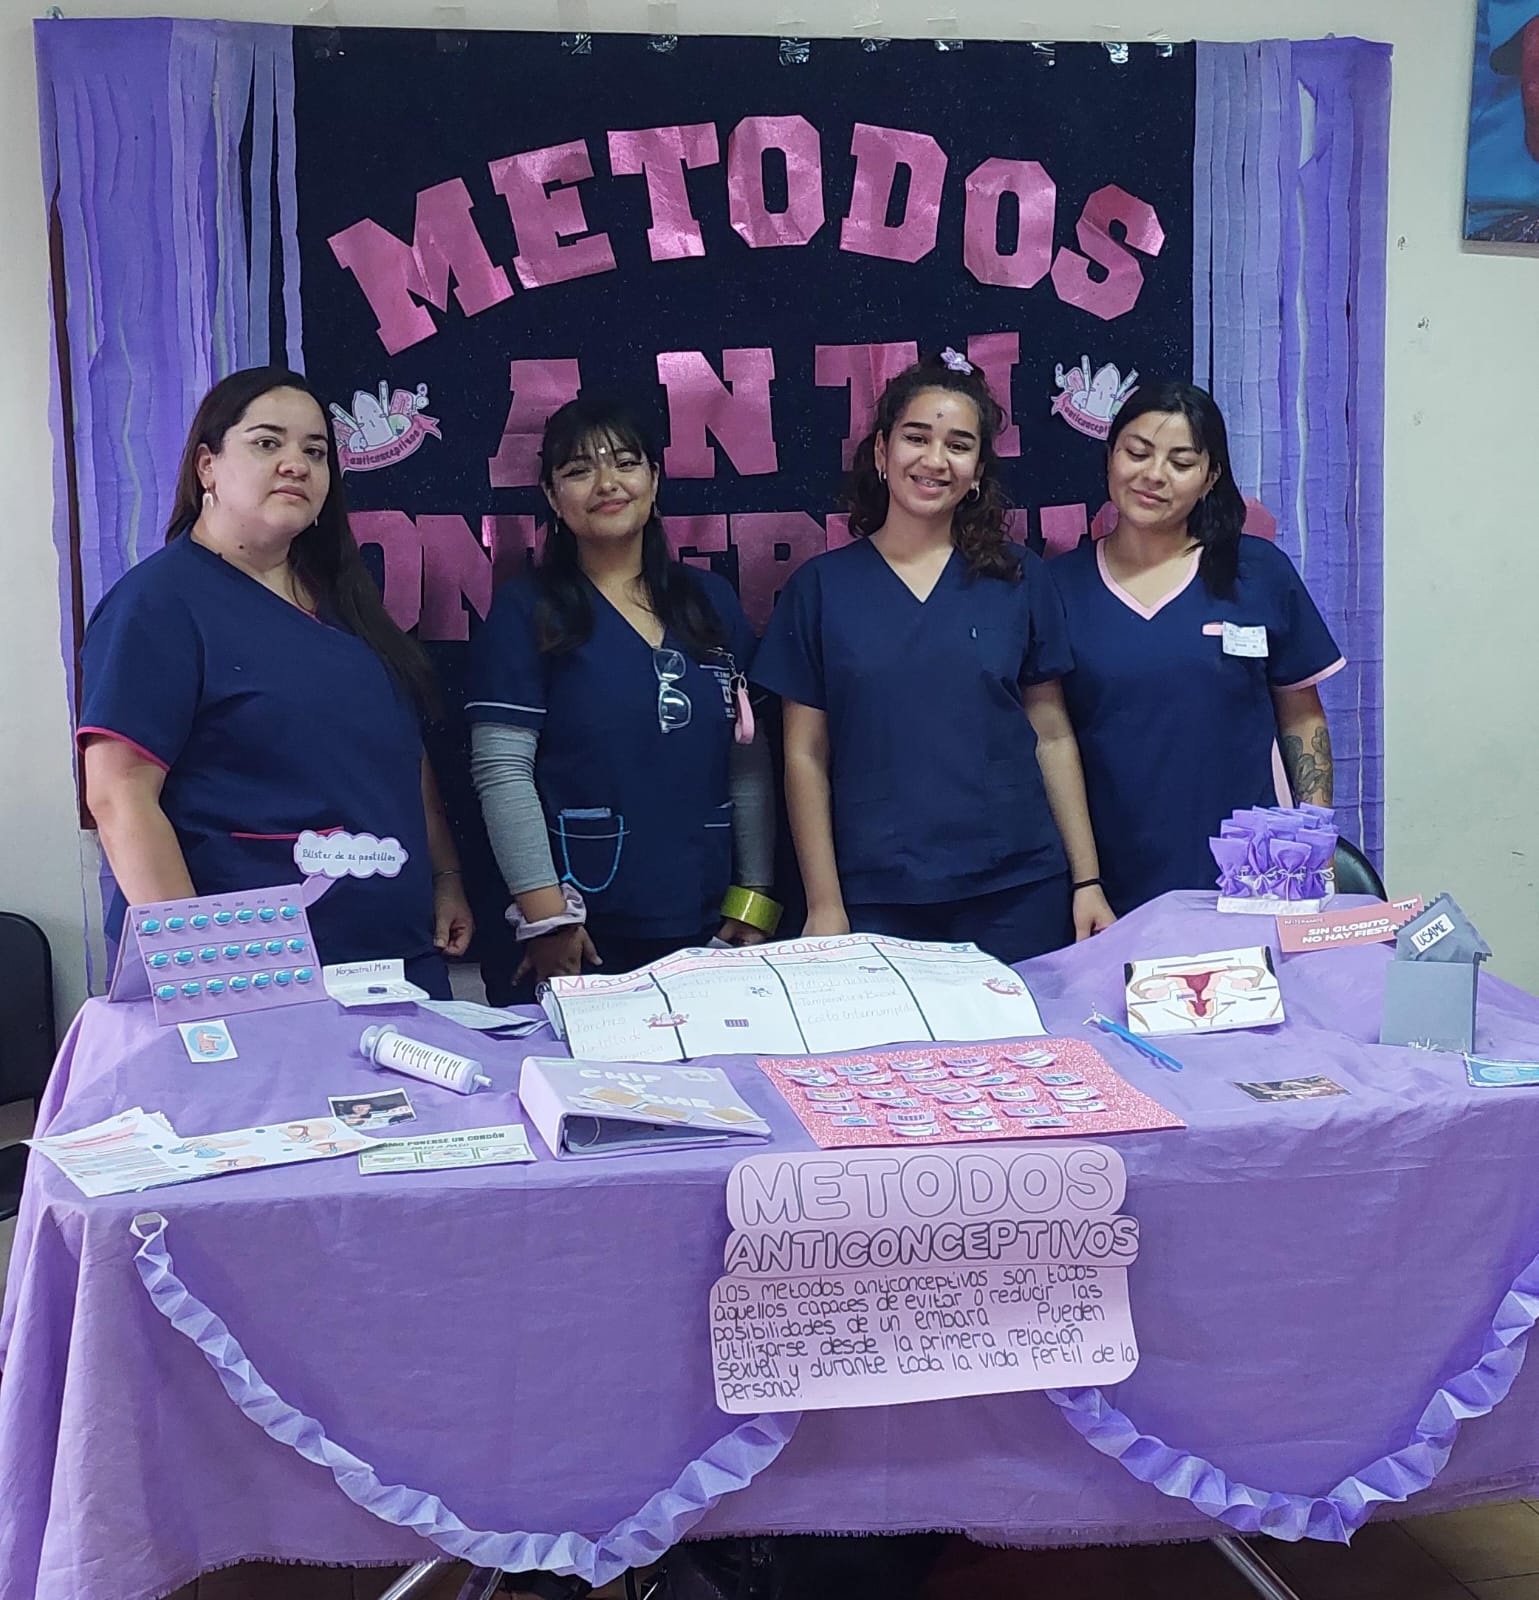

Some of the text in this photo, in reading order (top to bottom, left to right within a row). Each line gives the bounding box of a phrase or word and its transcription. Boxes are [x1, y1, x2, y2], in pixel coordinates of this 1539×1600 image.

[327, 114, 1166, 356] METODOS
[488, 332, 1020, 488] ANTI
[1302, 924, 1399, 944] NO HAY FIESTA
[1308, 927, 1330, 936] SIN
[1333, 918, 1390, 934] GLOBITO
[1415, 920, 1448, 947] USAME
[579, 1069, 662, 1083] CHIP
[739, 1149, 1113, 1226] METODOS
[726, 1218, 1139, 1273] ANTICONCEPTIVOS
[761, 1278, 845, 1300] metodos
[854, 1270, 988, 1296] anticonceptivos
[1003, 1267, 1036, 1286] son
[1047, 1264, 1098, 1282] todos
[713, 1318, 836, 1344] posibilidades
[847, 1314, 869, 1335] de
[880, 1315, 900, 1333] un
[1037, 1300, 1106, 1324] Pueden
[714, 1302, 788, 1329] aquellos
[798, 1298, 869, 1318] capaces
[876, 1292, 899, 1311] de
[905, 1291, 963, 1310] evitar
[990, 1285, 1054, 1304] reducir
[1072, 1284, 1103, 1300] las
[820, 1335, 879, 1356] desde
[893, 1335, 914, 1353] la
[920, 1331, 996, 1355] primera
[717, 1358, 780, 1381] sexual
[788, 1362, 801, 1391] y
[810, 1354, 888, 1378] durante
[897, 1354, 945, 1374] toda
[951, 1352, 973, 1370] la
[978, 1348, 1019, 1369] vida
[1091, 1343, 1115, 1363] de
[1120, 1342, 1136, 1363] la
